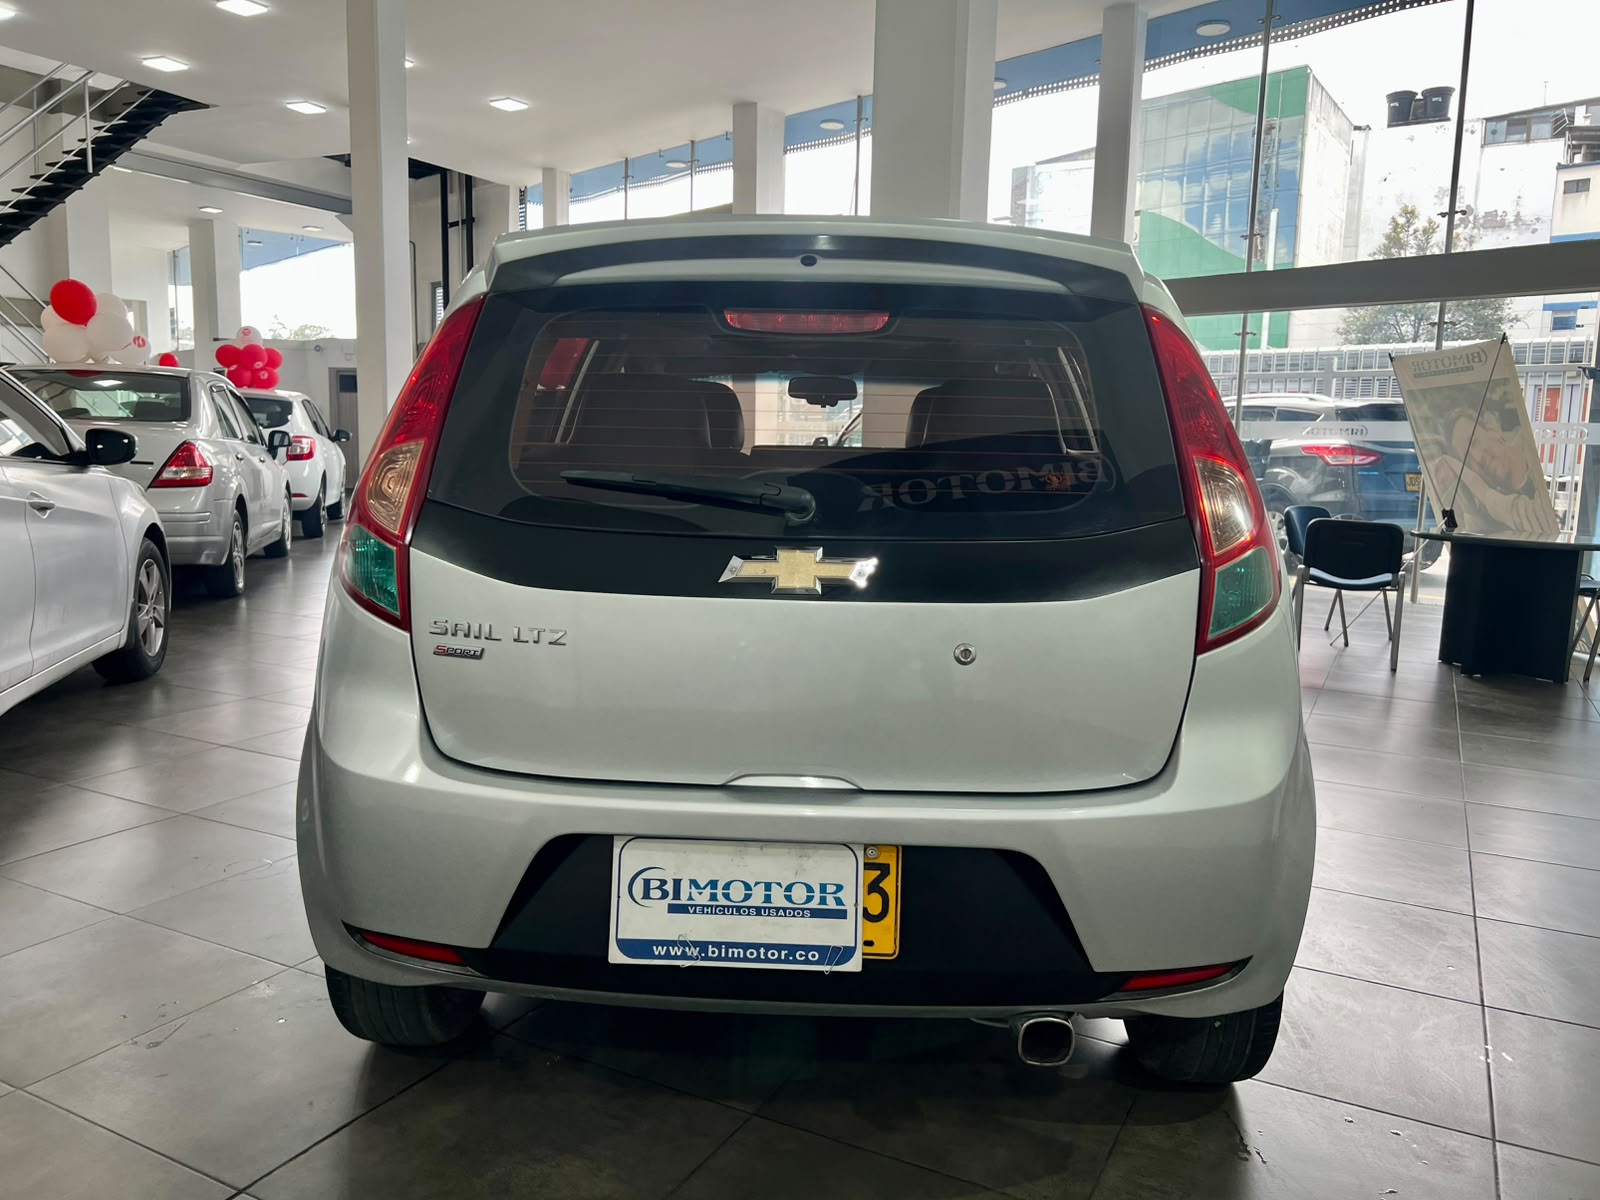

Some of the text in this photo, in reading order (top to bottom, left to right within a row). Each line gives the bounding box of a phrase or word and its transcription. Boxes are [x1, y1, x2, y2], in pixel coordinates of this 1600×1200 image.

[429, 619, 567, 646] SAIL LTZ
[640, 878, 847, 907] BIMOTOR
[863, 862, 890, 923] 3
[761, 907, 812, 918] USADOS
[652, 944, 820, 961] www.bimotor.co
